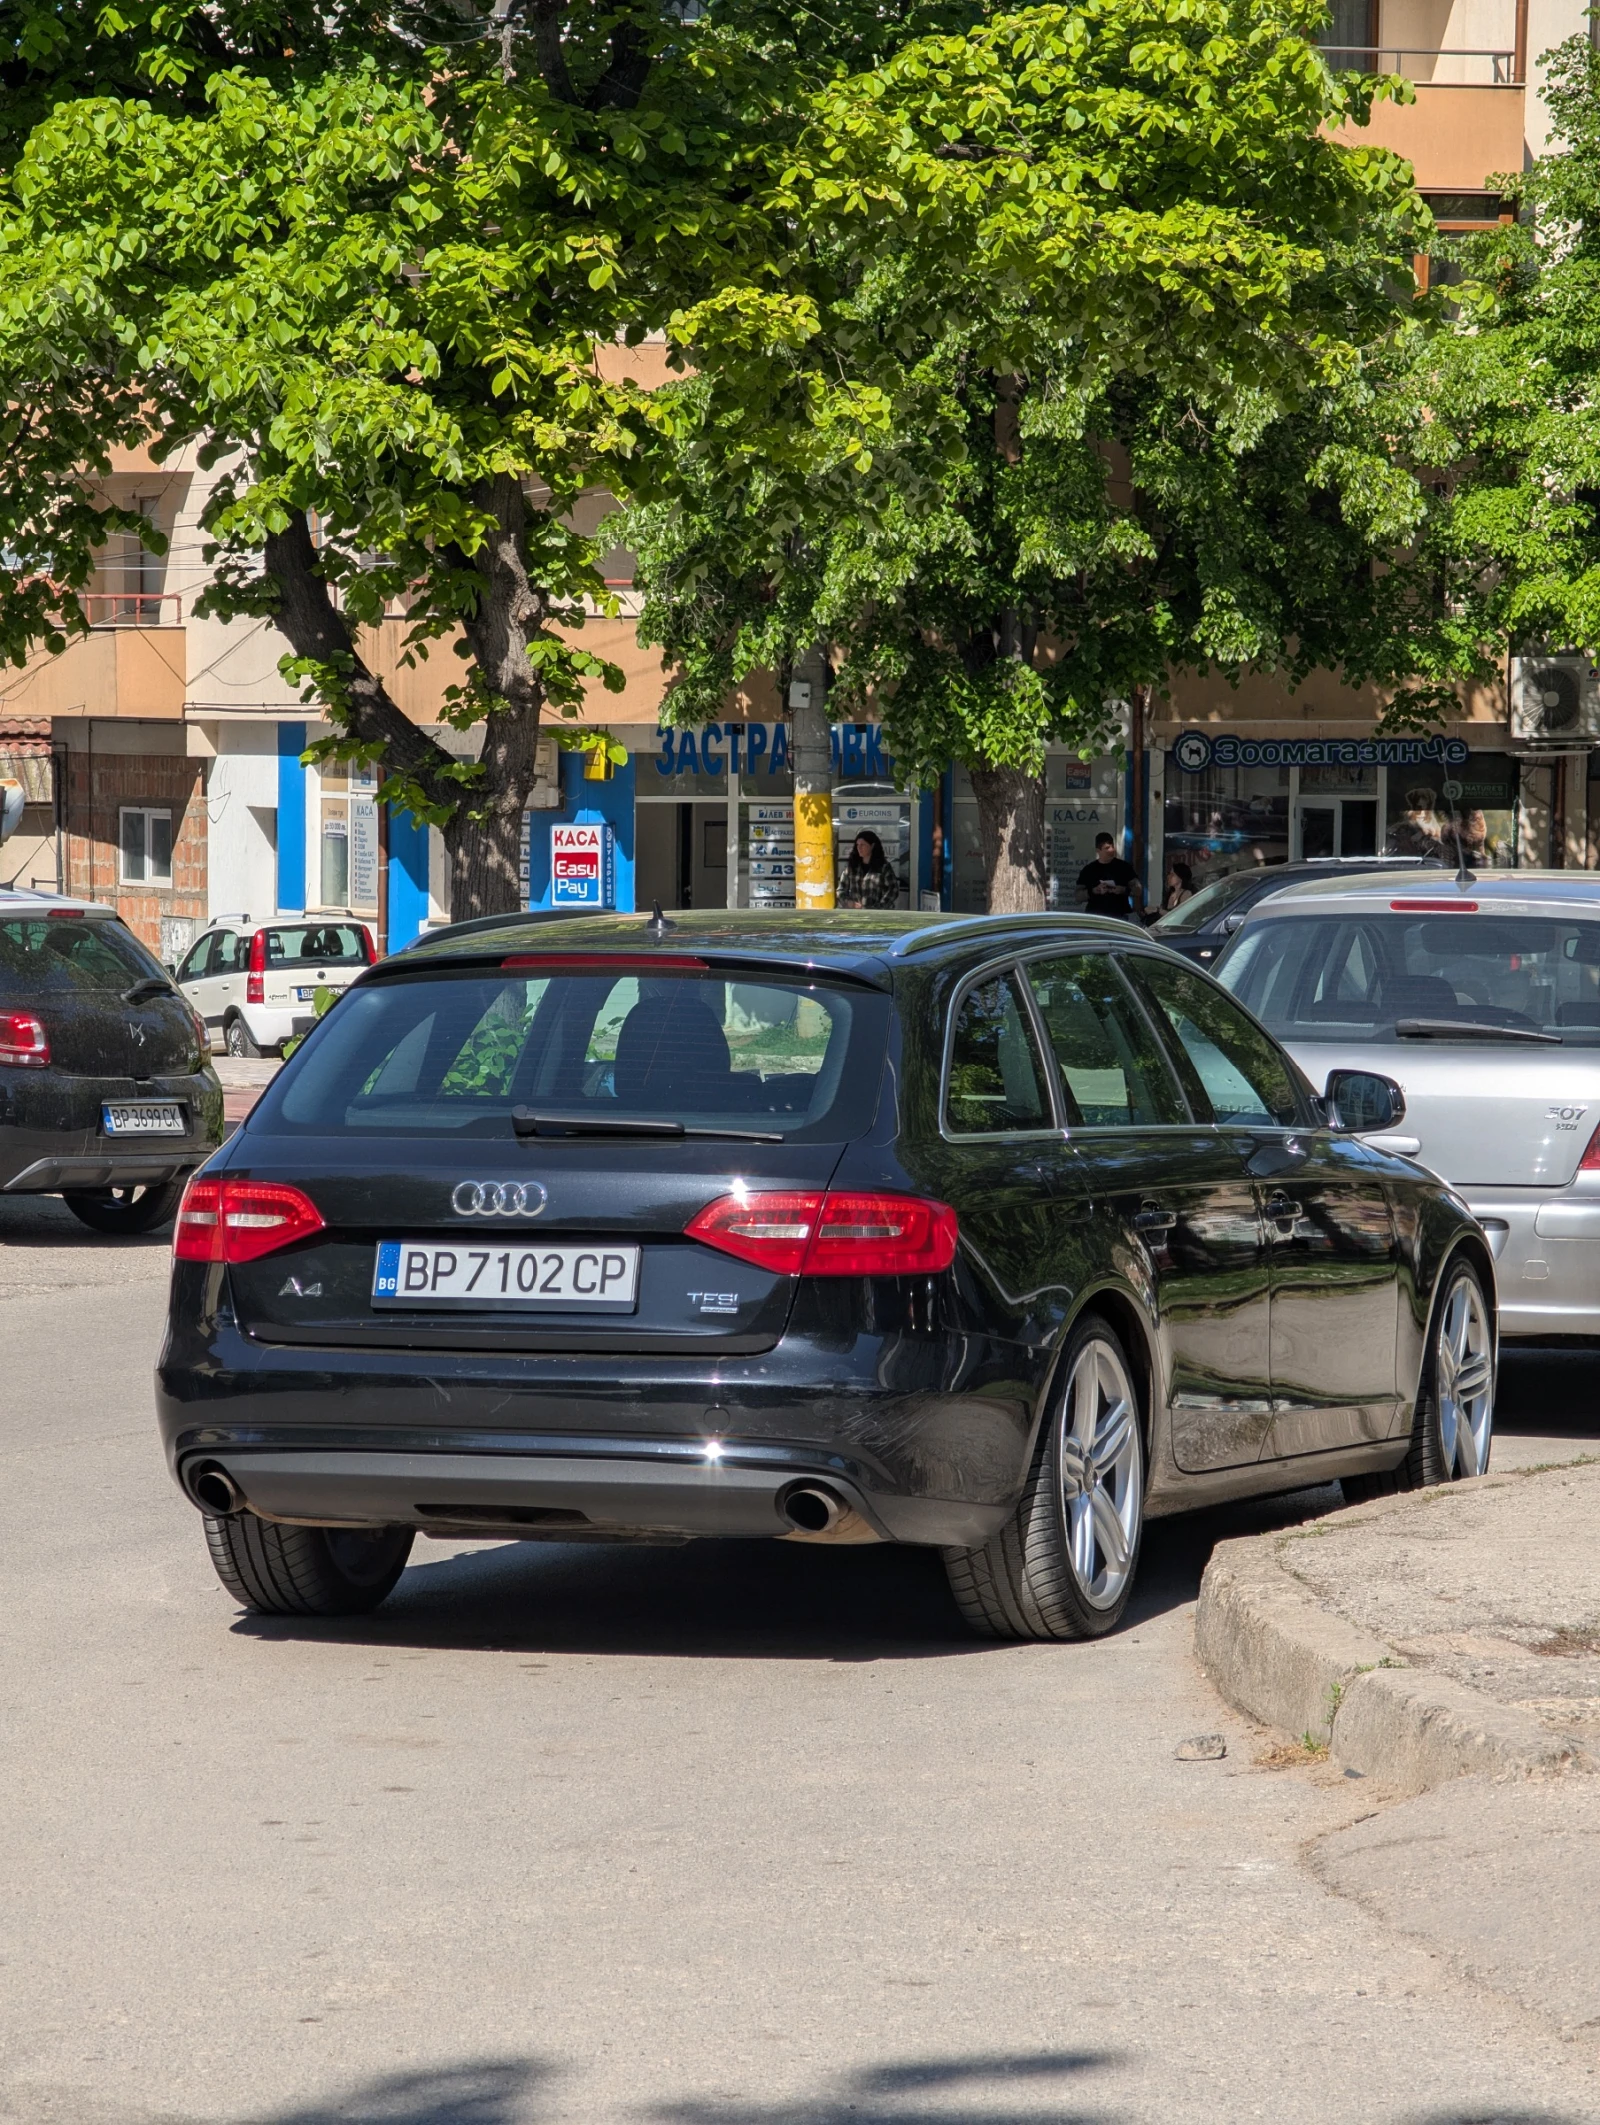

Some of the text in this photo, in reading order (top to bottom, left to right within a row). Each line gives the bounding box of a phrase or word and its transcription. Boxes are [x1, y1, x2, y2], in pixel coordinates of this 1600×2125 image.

[1067, 768, 1091, 780] Easy
[1067, 780, 1086, 788] Pay
[356, 805, 373, 817] КАСА
[1053, 809, 1100, 822] КАСА
[554, 830, 599, 847] КАСА
[1054, 835, 1071, 843] Вода
[556, 860, 597, 880] Easy
[771, 864, 795, 875] ДЗ
[558, 879, 588, 899] Pay
[112, 1108, 180, 1128] BP 3699 CK
[1544, 1106, 1588, 1120] 307
[404, 1251, 626, 1294] BP 7102 CP
[278, 1277, 322, 1297] A4
[378, 1277, 396, 1291] BG
[687, 1292, 738, 1305] TFSI
